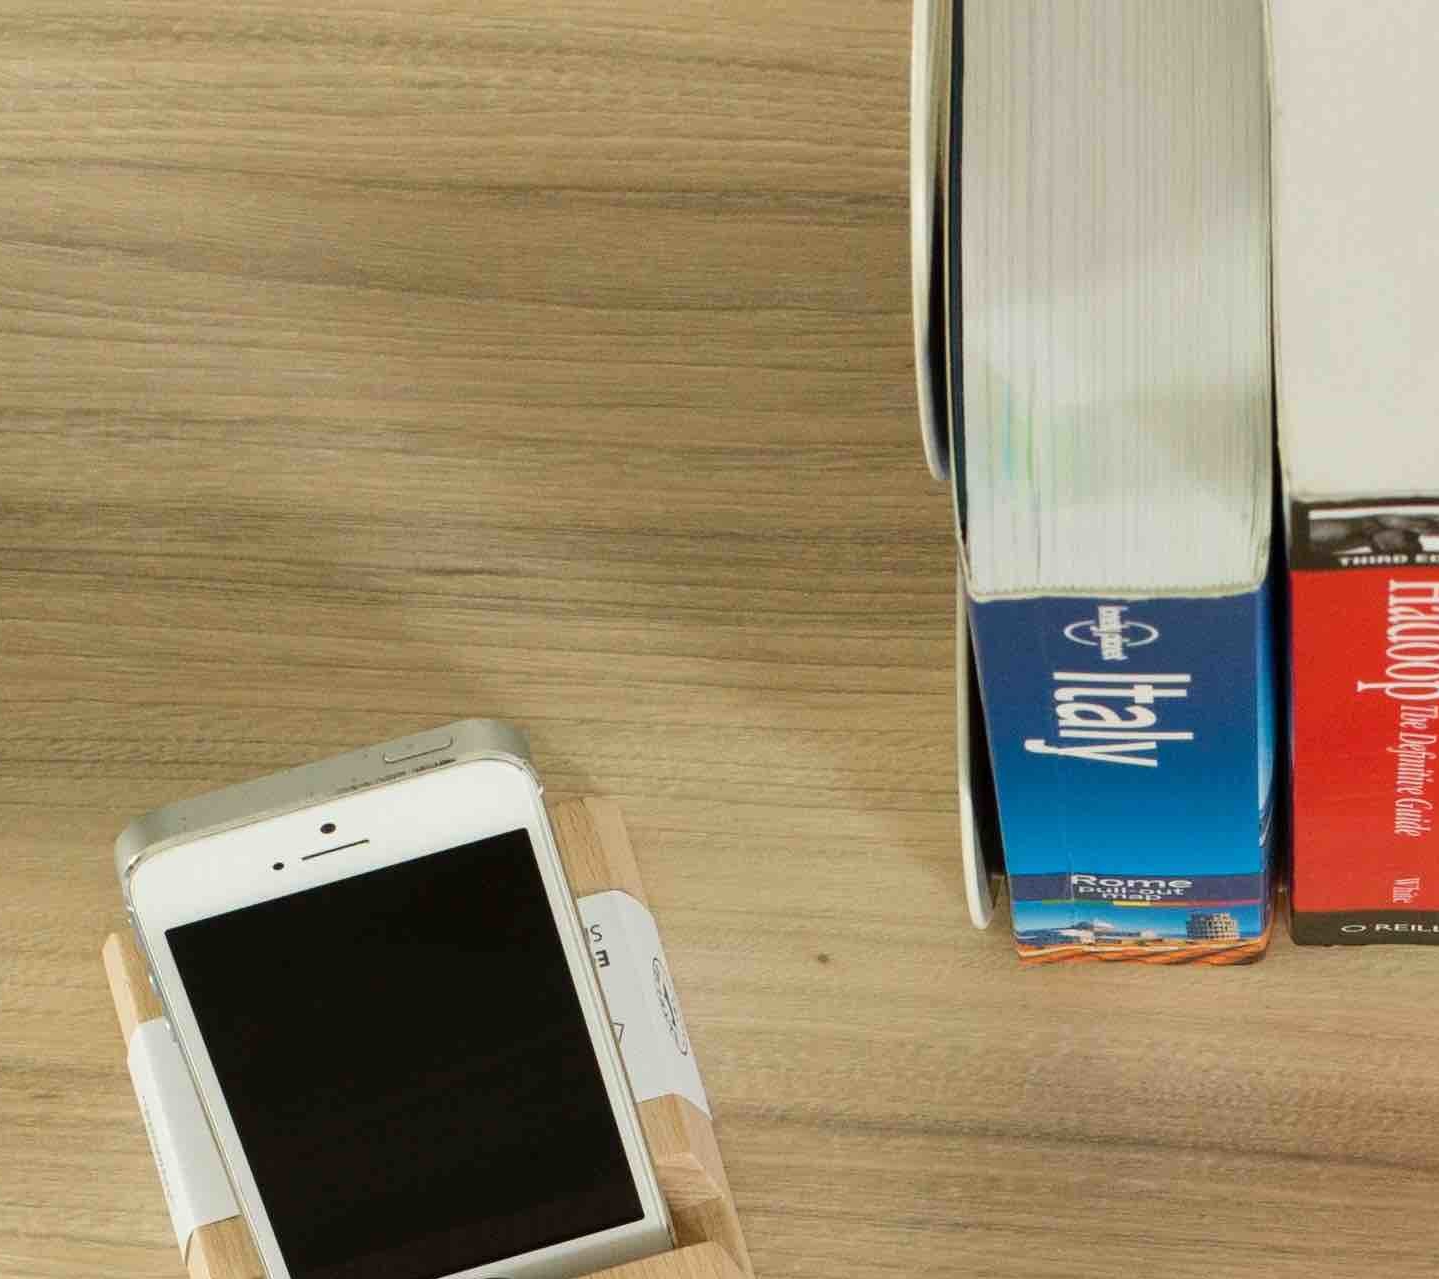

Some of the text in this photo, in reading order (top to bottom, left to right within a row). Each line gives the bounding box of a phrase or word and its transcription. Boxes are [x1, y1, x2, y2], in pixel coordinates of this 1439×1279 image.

[1338, 554, 1408, 566] THIRD
[1024, 672, 1194, 767] Italy
[1397, 704, 1439, 730] The
[1389, 730, 1437, 796] Definitive
[1393, 796, 1433, 837] Guide
[1071, 875, 1193, 889] Rome
[1078, 887, 1187, 896] pull-out
[1392, 877, 1421, 904] White
